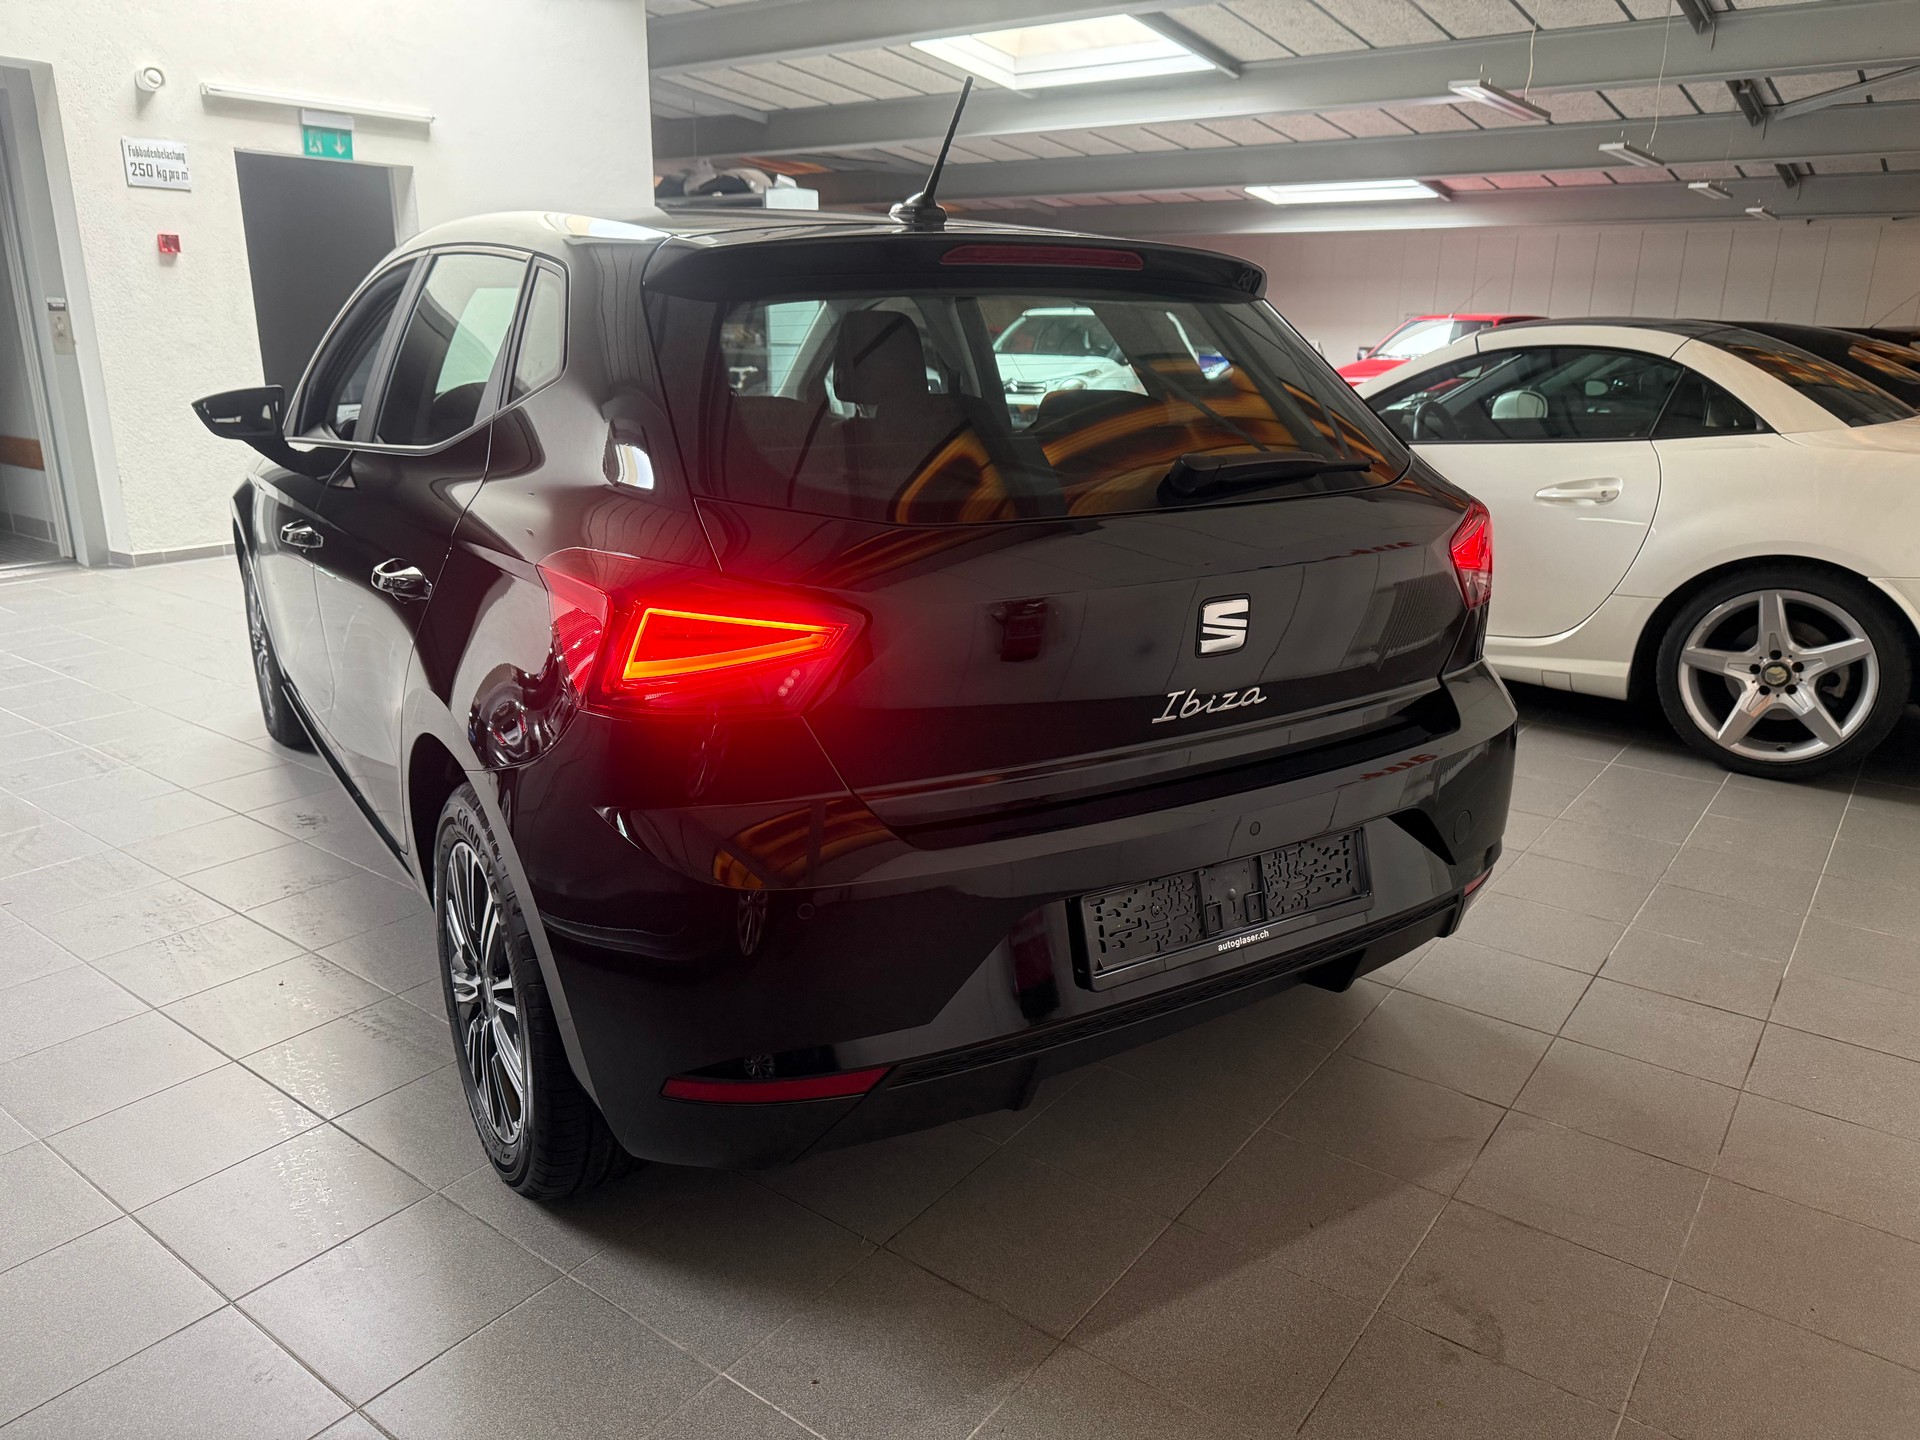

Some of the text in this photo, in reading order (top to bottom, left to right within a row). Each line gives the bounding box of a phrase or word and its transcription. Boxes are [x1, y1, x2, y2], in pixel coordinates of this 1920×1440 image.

[130, 162, 153, 178] 250
[156, 164, 168, 182] kg
[168, 169, 180, 182] pro
[1151, 687, 1268, 724] Ibiza
[1217, 929, 1270, 952] autoglaser.ch
